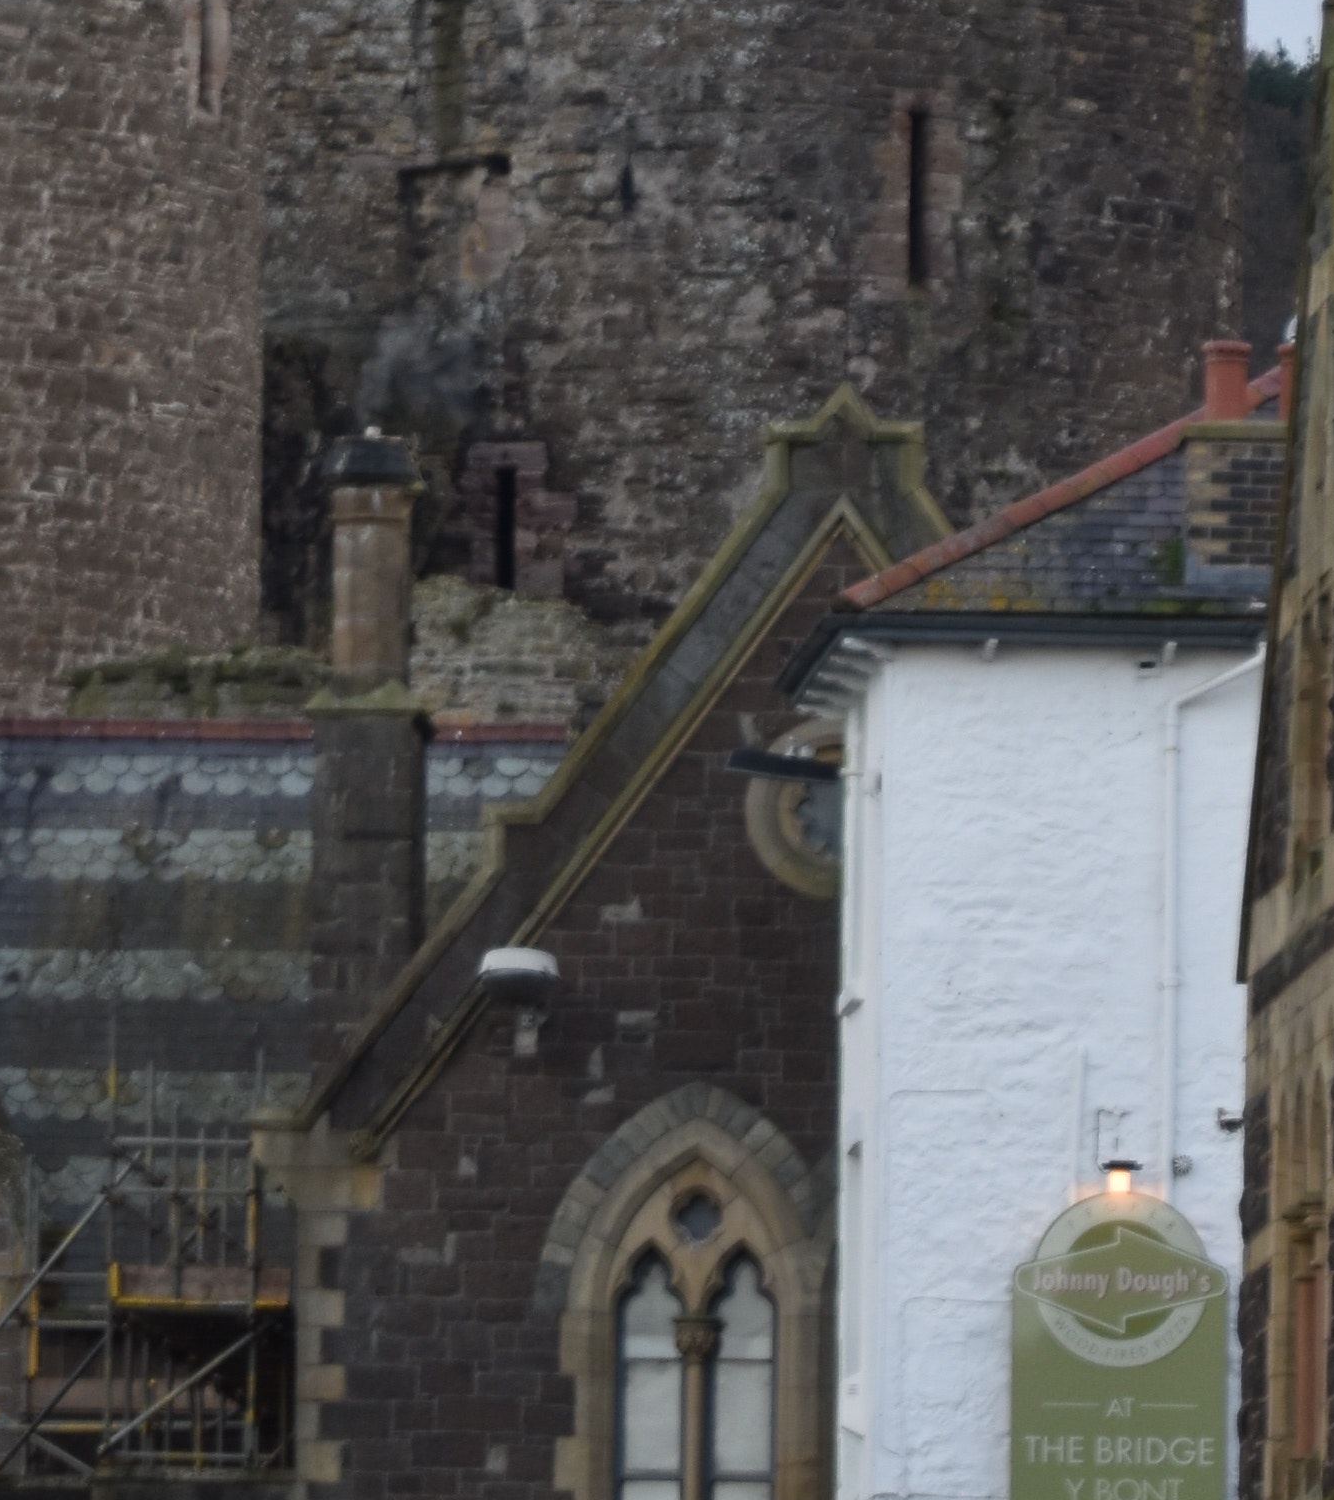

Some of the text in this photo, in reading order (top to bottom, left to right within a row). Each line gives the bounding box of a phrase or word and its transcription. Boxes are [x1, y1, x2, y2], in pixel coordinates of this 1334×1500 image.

[1033, 1266, 1212, 1299] Johnny Dough's
[1106, 1397, 1135, 1418] AT
[1025, 1435, 1216, 1466] THE BRIDGE
